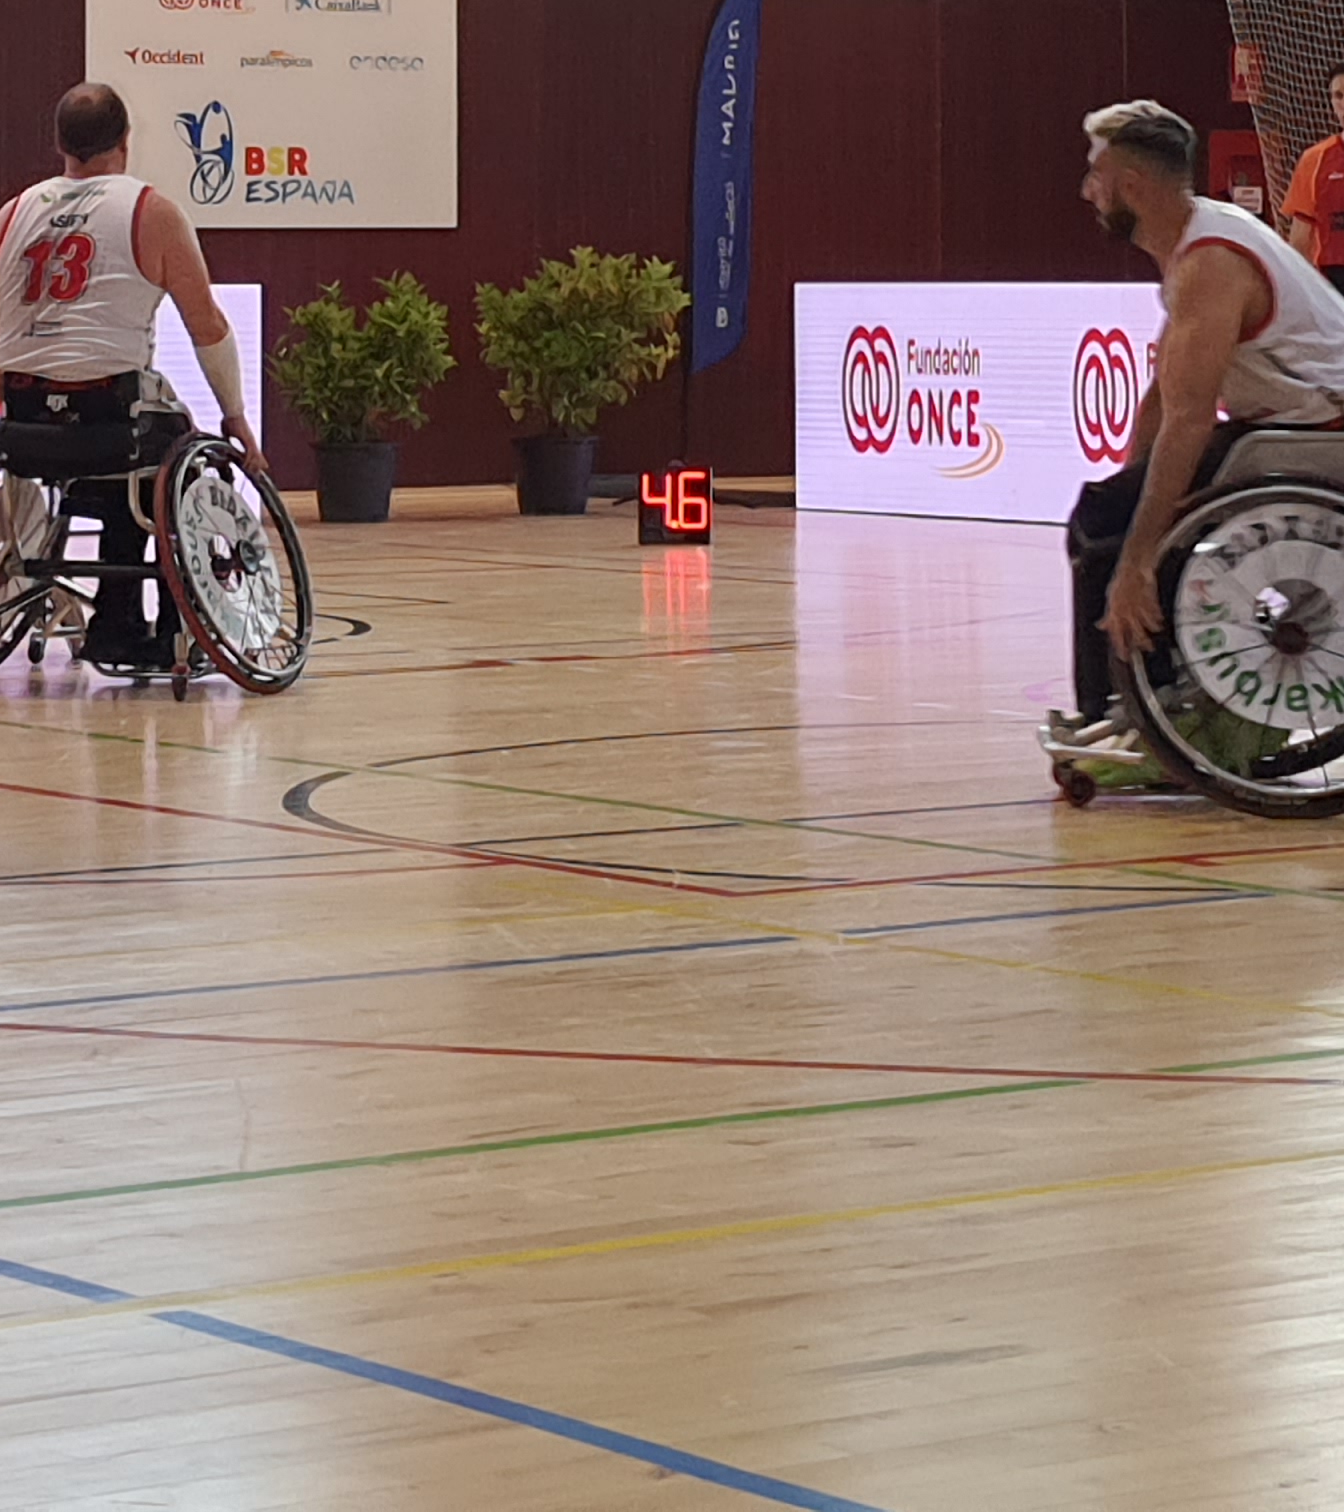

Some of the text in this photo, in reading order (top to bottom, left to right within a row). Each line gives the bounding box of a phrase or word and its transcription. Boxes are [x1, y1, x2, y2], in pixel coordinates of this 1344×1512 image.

[142, 50, 204, 66] Occident
[245, 146, 308, 176] BSR
[245, 179, 355, 205] ESPAÑA
[20, 231, 96, 306] 13
[907, 338, 981, 377] Fundación
[907, 389, 980, 448] ONCE
